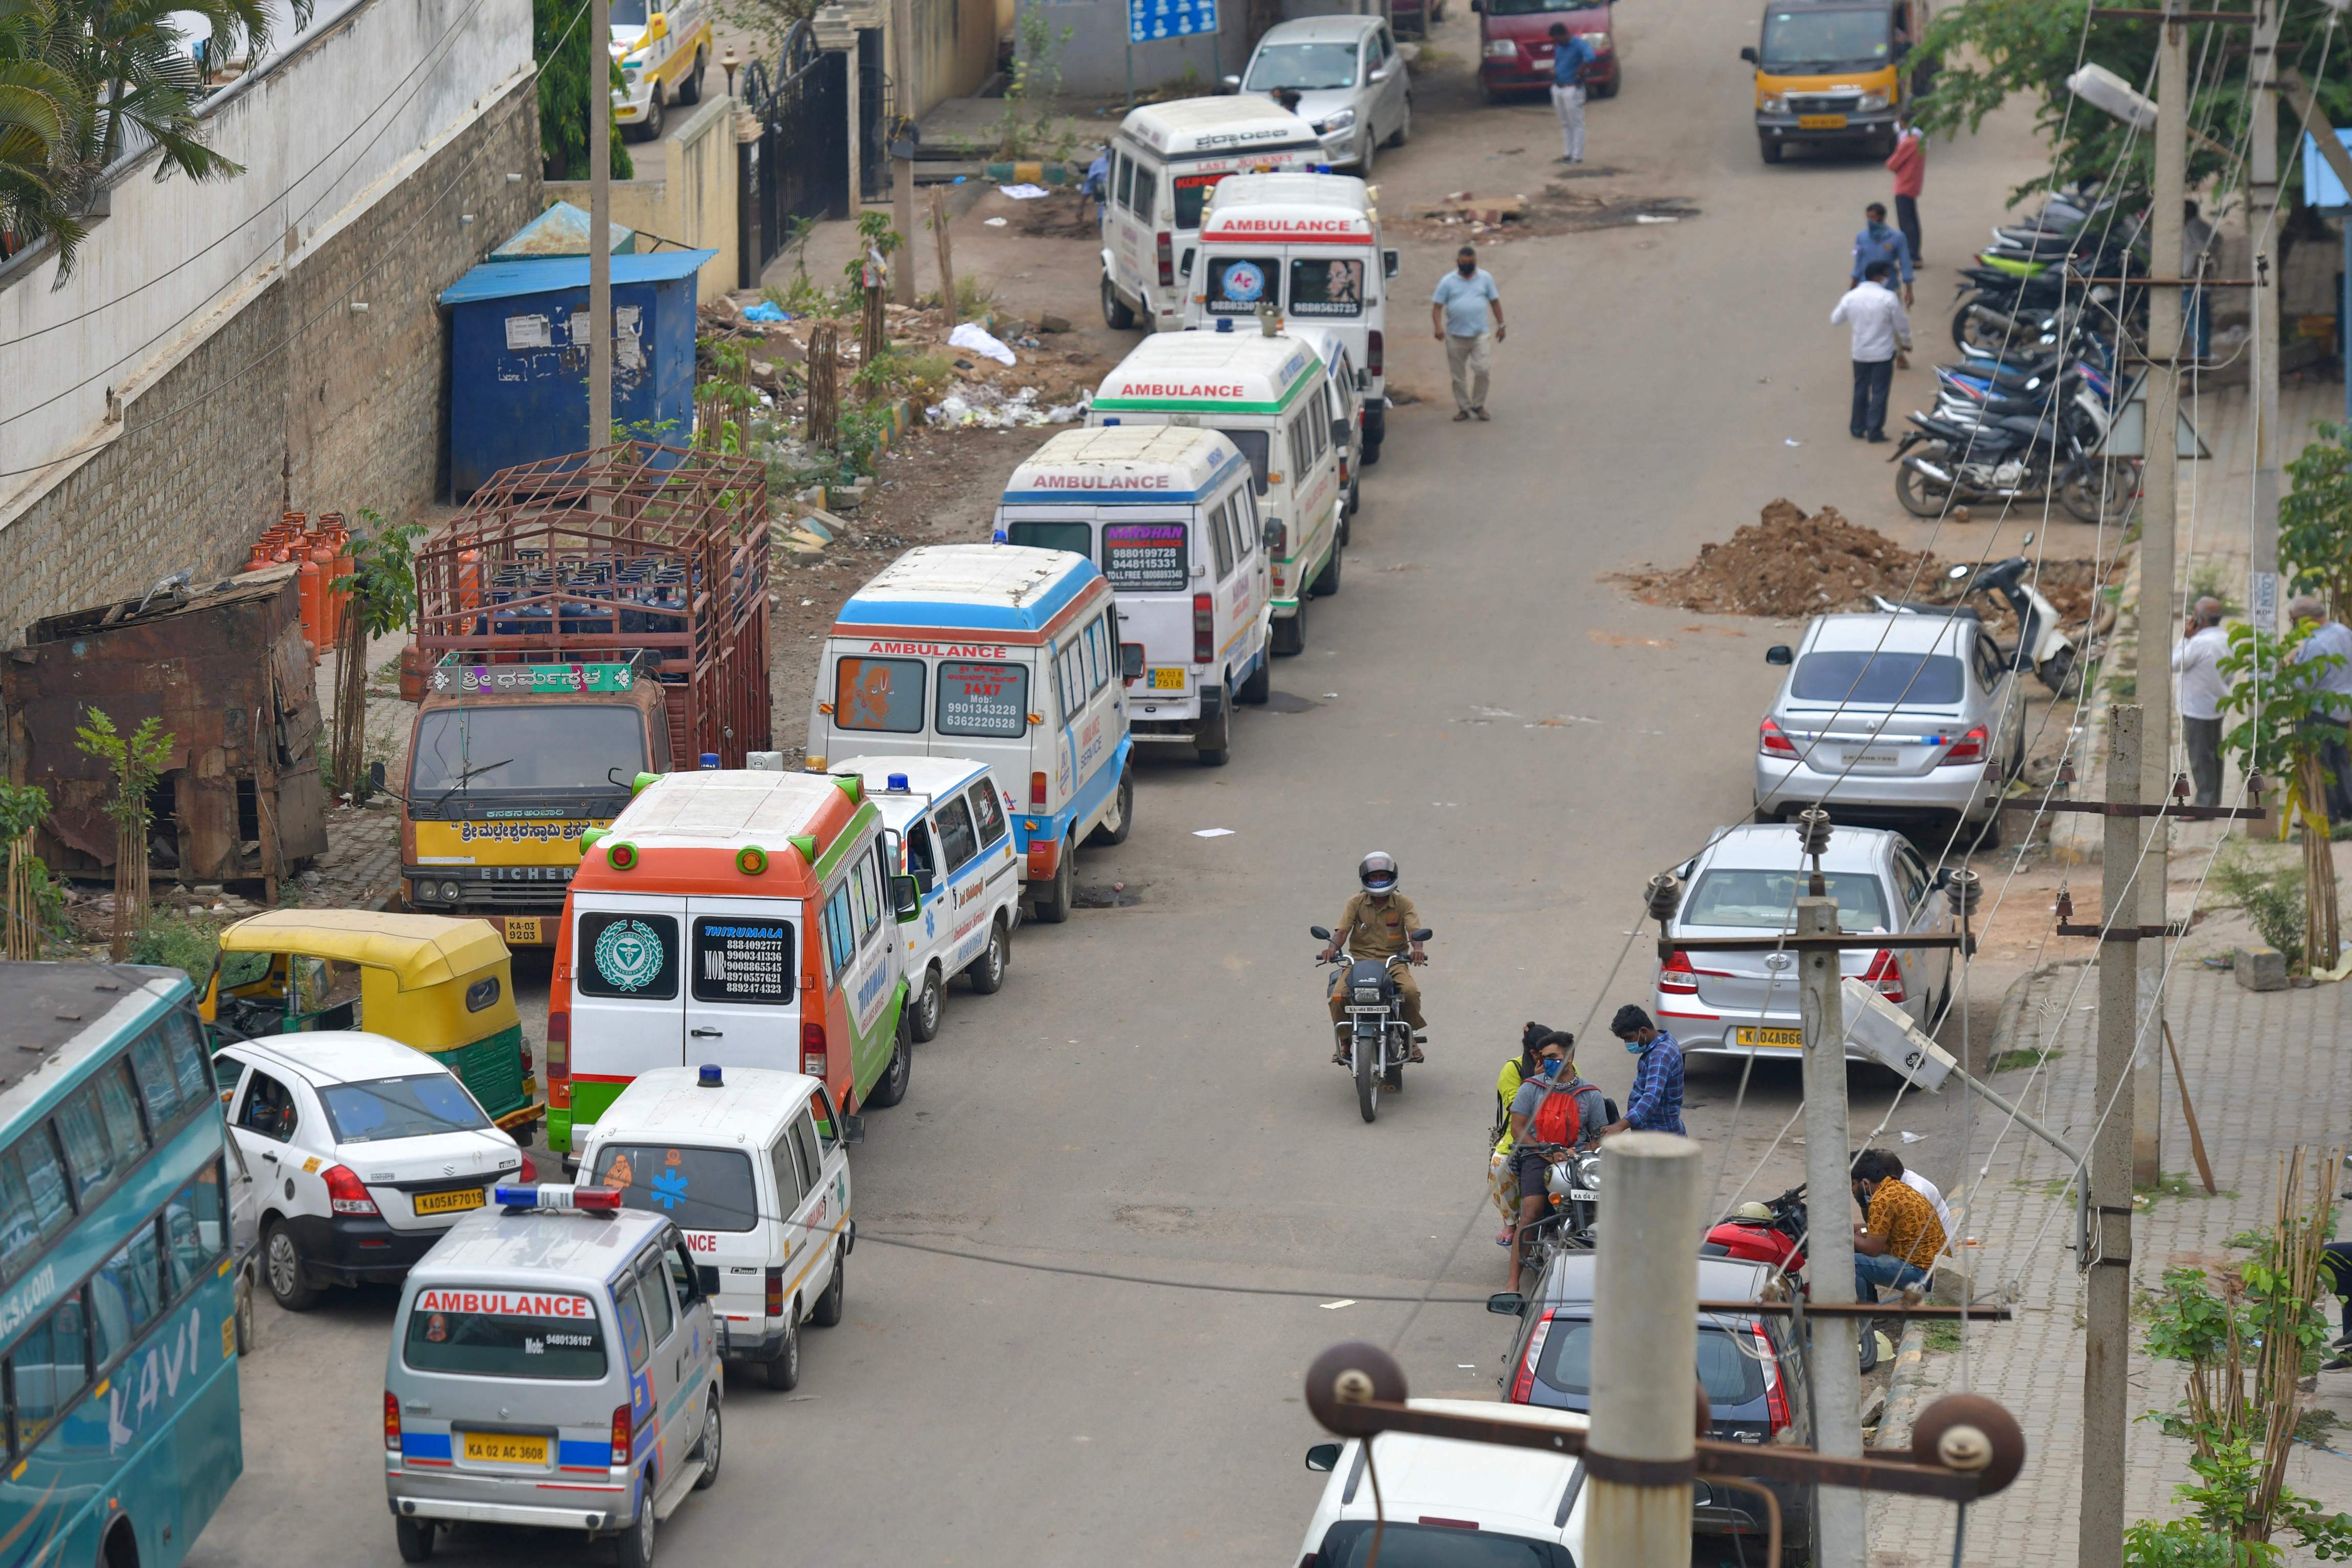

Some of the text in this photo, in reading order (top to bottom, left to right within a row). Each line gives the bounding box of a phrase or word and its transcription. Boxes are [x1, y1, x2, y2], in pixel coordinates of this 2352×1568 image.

[1197, 155, 1293, 172] LAST JOURNEY
[1223, 220, 1351, 231] AMBULANCE
[1121, 383, 1244, 397] AMBULANCE
[1033, 475, 1169, 489] AMBULANCE
[1107, 526, 1184, 539] NANDHAN
[1113, 548, 1177, 558] 9880199728
[1113, 558, 1177, 569] 9448115331
[1106, 571, 1124, 579] TOLL
[1125, 571, 1141, 579] FREE
[869, 642, 1007, 658] AMBULANCE
[461, 669, 601, 691] ಶ್ರೀ ಧರ್ಮಸ್ಥಳ
[964, 683, 1001, 695] 24X7
[970, 695, 992, 703] Mob:
[947, 703, 1016, 715] 9901343228
[947, 715, 1015, 729] 6362220528
[481, 868, 574, 879] EICHER
[973, 908, 986, 928] Service
[509, 922, 535, 930] KA-03
[705, 926, 783, 938] THIRUMALA
[509, 931, 535, 940] 9203
[727, 940, 782, 950] 8884092777
[727, 950, 782, 961] 9900341336
[704, 950, 782, 980] MOB: 9008865545
[727, 972, 781, 983] 8970557621
[727, 983, 782, 993] 8892474323
[858, 957, 887, 1018] THIRUMALA
[874, 993, 884, 1016] SERVICE
[422, 1192, 483, 1210] KA05AF7019
[423, 1292, 586, 1316] AMBULANCE
[525, 1334, 592, 1354] Mob: 9480136187
[469, 1444, 544, 1460] KA 02 AC 3608
